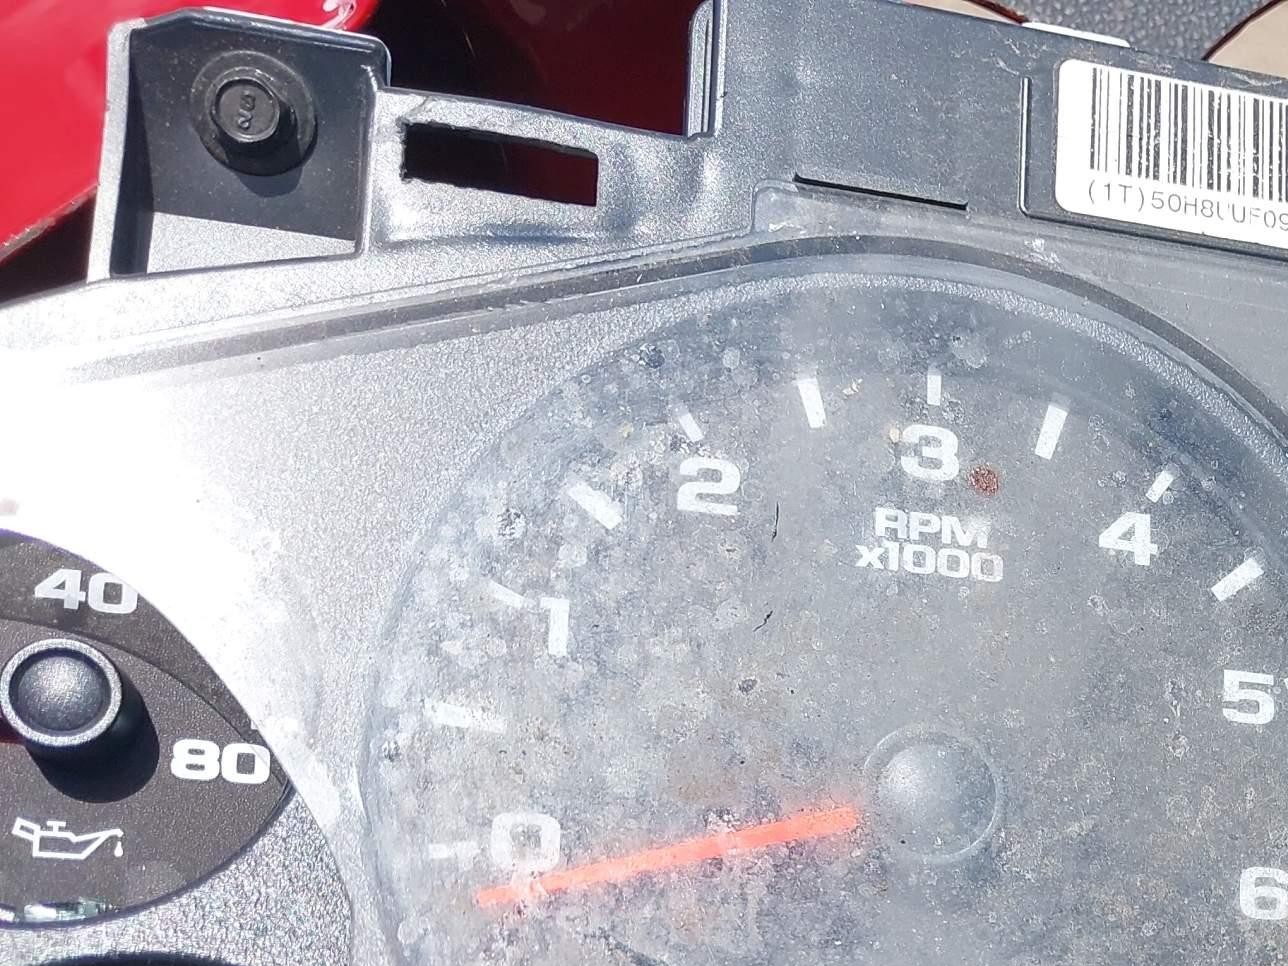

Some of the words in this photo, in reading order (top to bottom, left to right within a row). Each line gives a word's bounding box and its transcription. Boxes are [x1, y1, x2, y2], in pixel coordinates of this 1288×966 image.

[900, 424, 960, 481] 3
[676, 457, 740, 516] 2
[874, 507, 991, 549] RPM
[1099, 511, 1158, 566] 4
[855, 540, 1004, 583] x1000
[34, 568, 139, 614] 40
[540, 598, 569, 656] 1
[1222, 669, 1275, 725] 5
[171, 739, 271, 784] 80
[491, 811, 562, 870] 0
